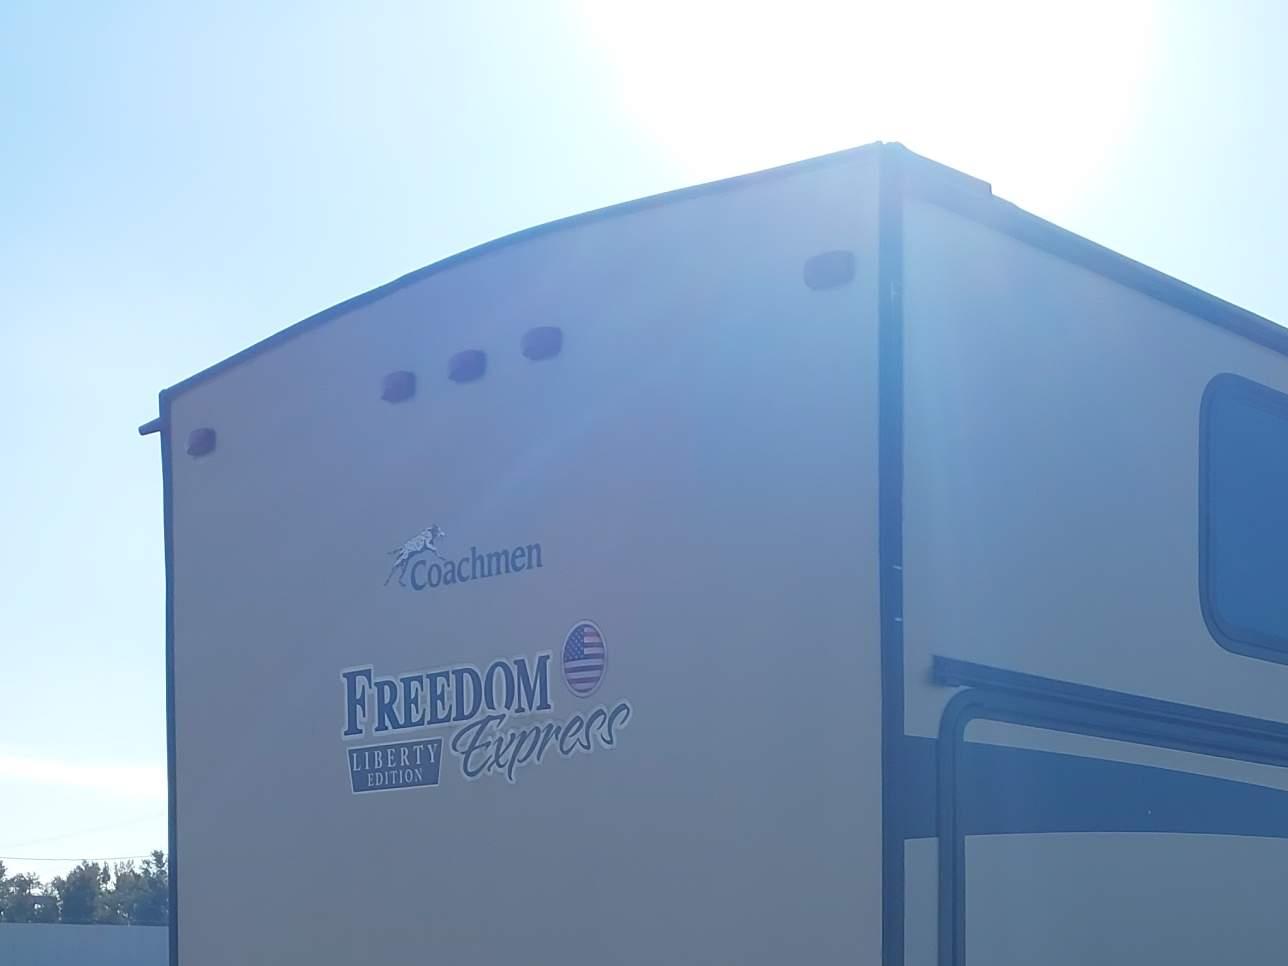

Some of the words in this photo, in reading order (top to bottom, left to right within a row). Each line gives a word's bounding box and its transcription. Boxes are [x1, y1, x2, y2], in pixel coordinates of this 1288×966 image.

[410, 541, 544, 592] Coachmen
[341, 653, 551, 737] FREEDOM
[351, 743, 438, 772] LIBERTY
[451, 702, 631, 782] Express
[367, 767, 424, 788] EDITION
